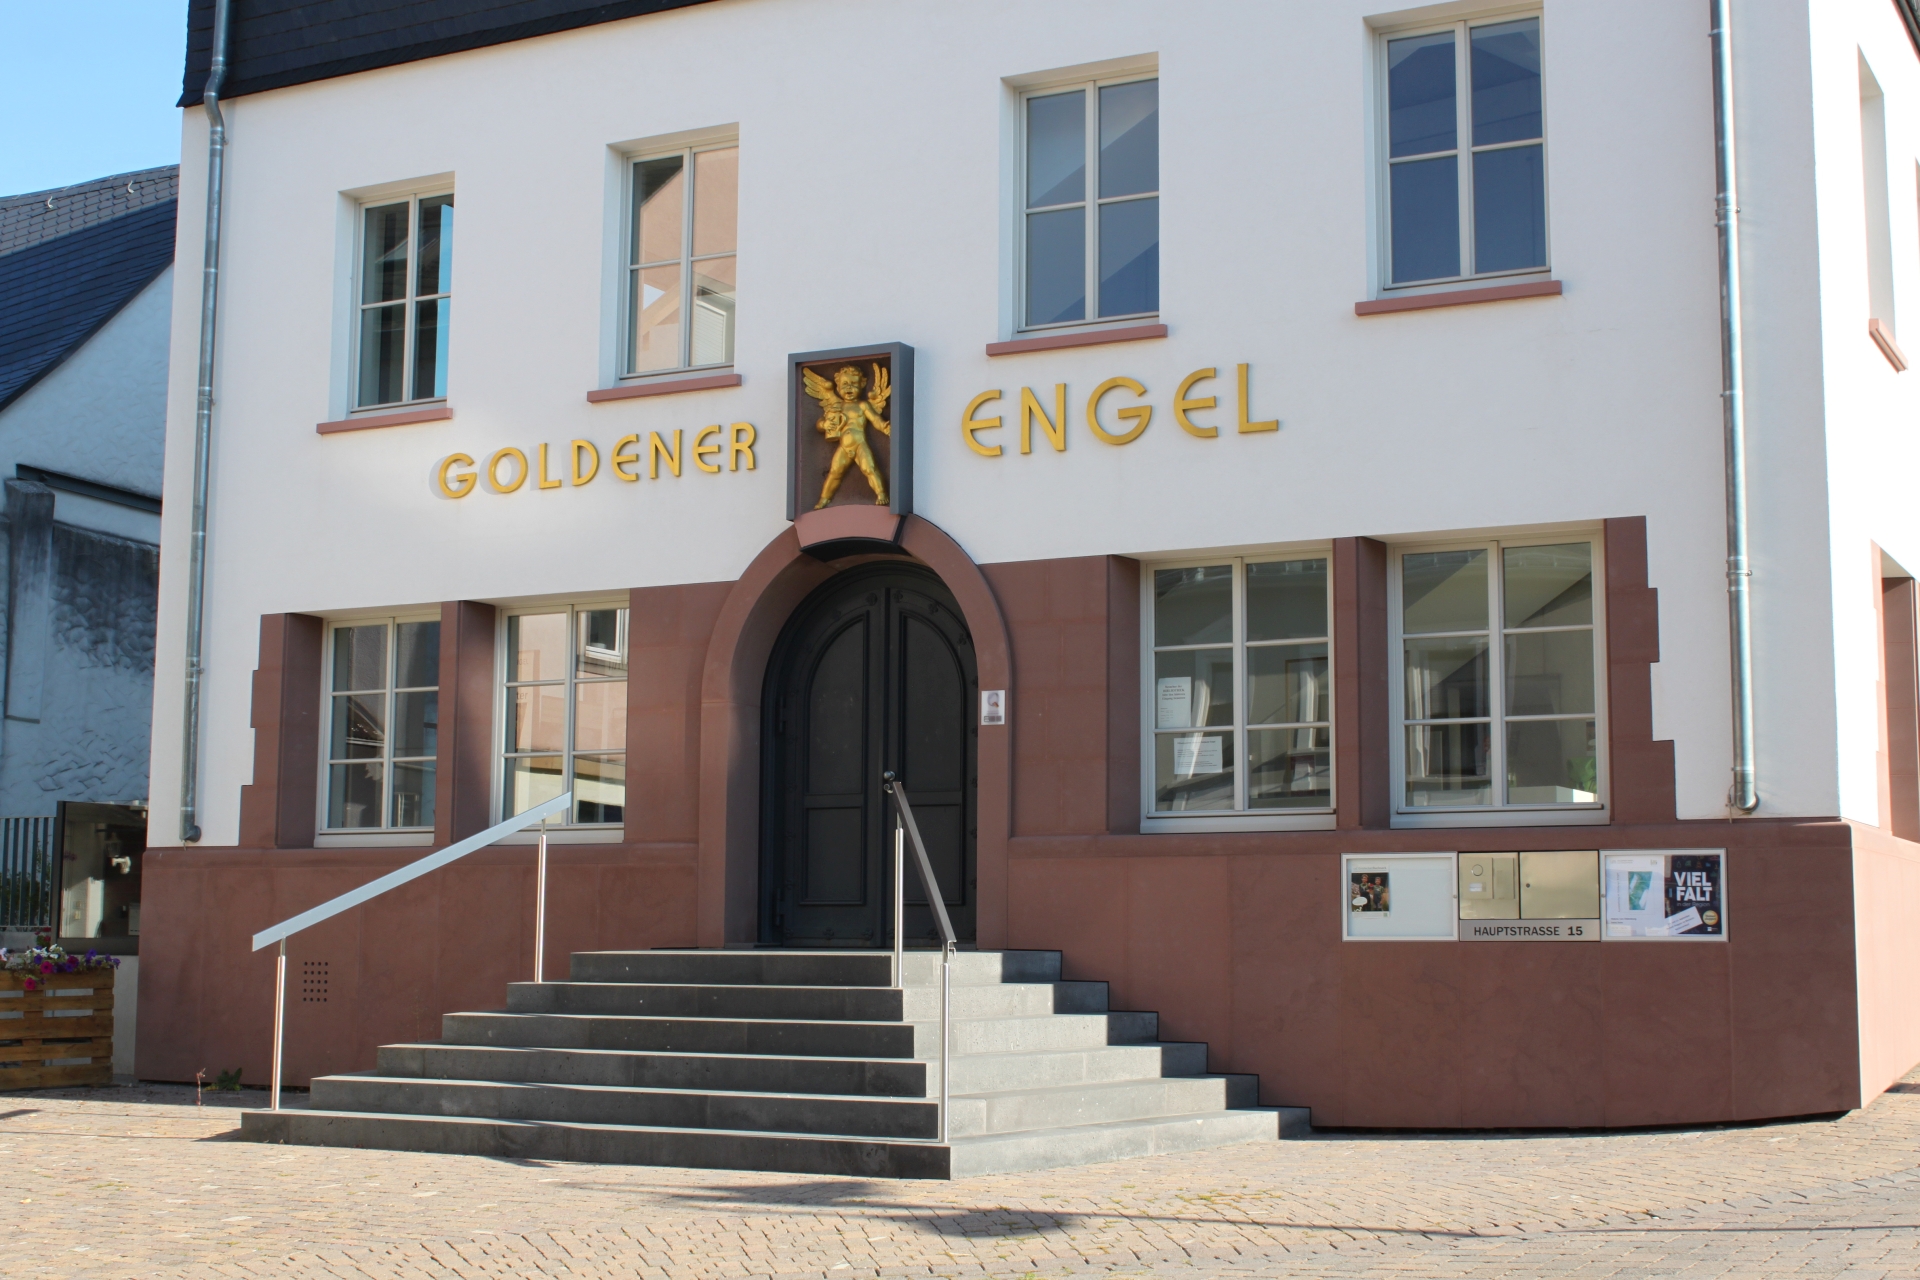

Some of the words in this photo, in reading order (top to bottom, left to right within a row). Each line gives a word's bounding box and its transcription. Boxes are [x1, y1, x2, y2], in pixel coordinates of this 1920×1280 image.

[437, 421, 757, 499] GOLDENER
[961, 362, 1279, 457] ENGEL
[1673, 871, 1712, 887] VIEL
[1676, 886, 1713, 901] FALT
[1474, 926, 1560, 936] HAUPTSTRASSE
[1567, 925, 1583, 936] 15
